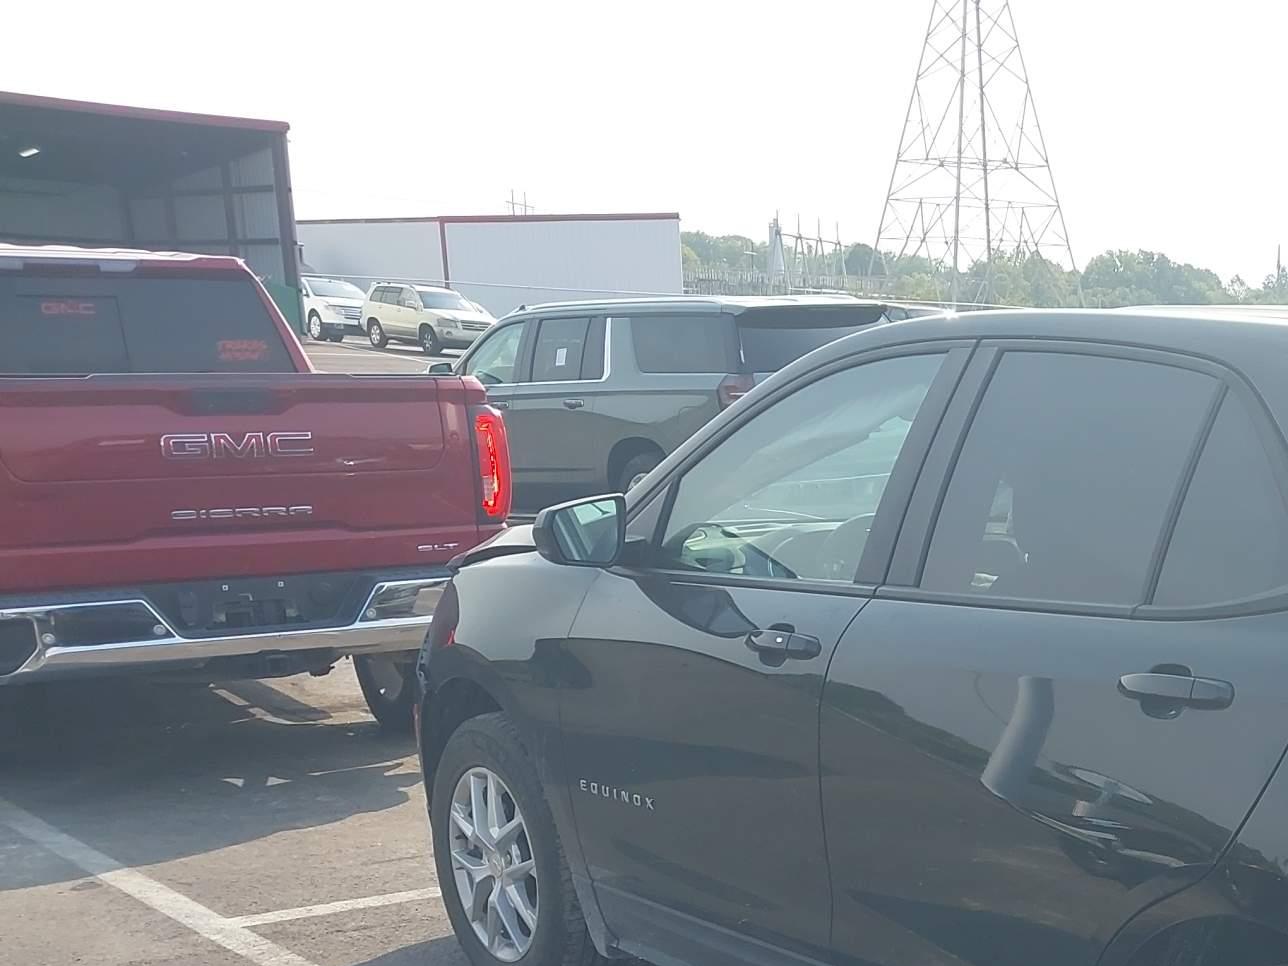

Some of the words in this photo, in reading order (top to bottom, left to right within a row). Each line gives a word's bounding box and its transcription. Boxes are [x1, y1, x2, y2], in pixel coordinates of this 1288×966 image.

[160, 431, 314, 459] GMC
[171, 505, 313, 520] SIERRA
[417, 543, 459, 552] SLT
[579, 779, 655, 810] EQUINOX
